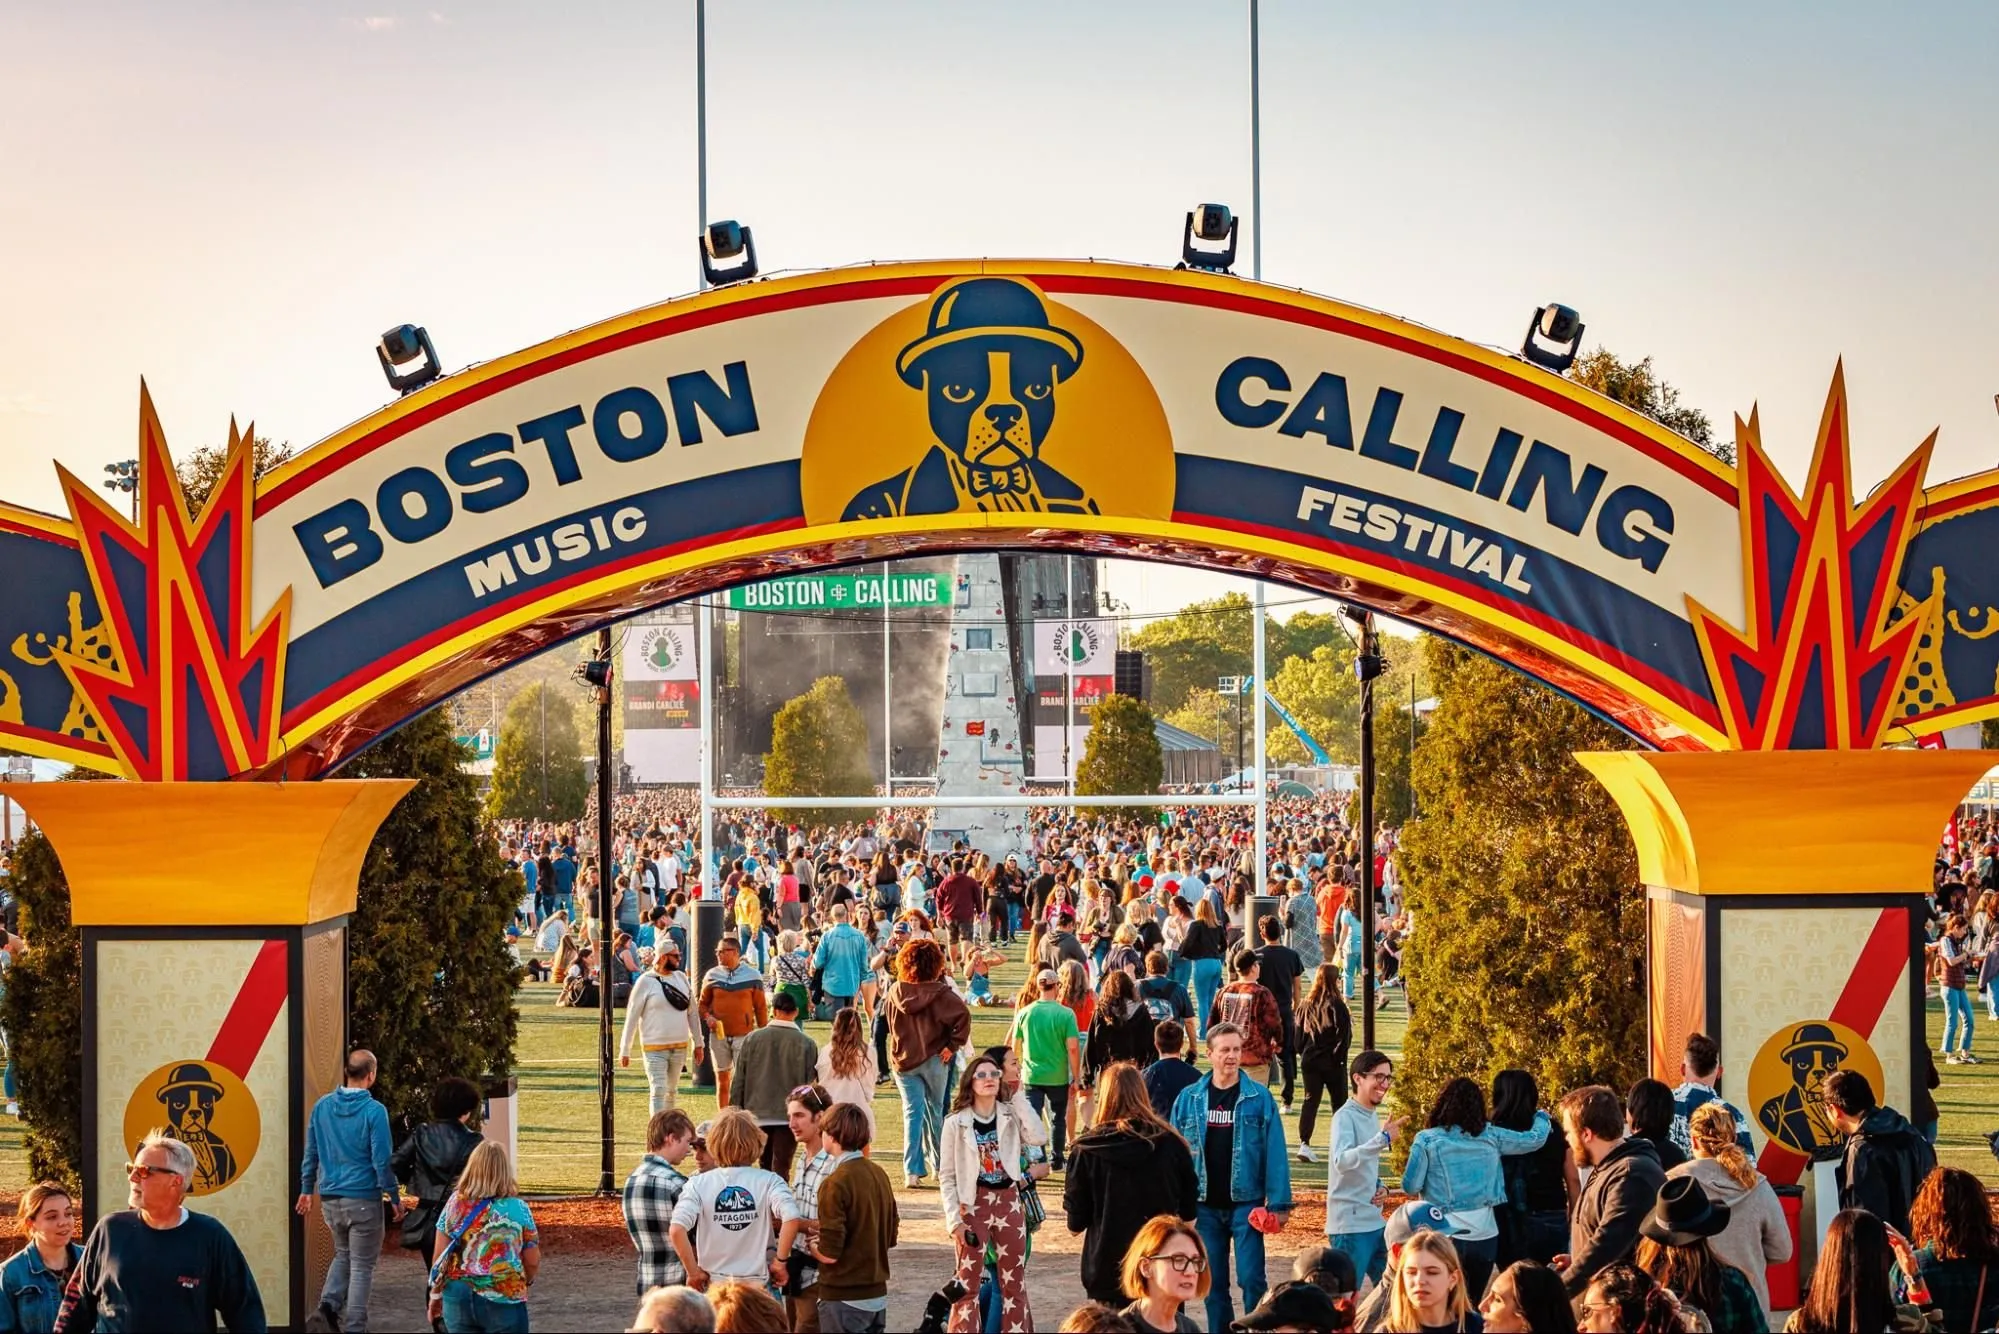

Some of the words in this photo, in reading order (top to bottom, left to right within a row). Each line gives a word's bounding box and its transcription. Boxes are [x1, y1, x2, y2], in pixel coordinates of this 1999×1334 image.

[293, 360, 760, 590] BOSTON
[1215, 356, 1675, 575] CALLING
[463, 506, 647, 598] MUSIC
[1296, 485, 1532, 595] FESTIVAL
[744, 581, 825, 606] BOSTON
[641, 628, 660, 657] BOSTON
[662, 627, 683, 657] CALLING
[713, 1212, 759, 1221] PATAGONIA
